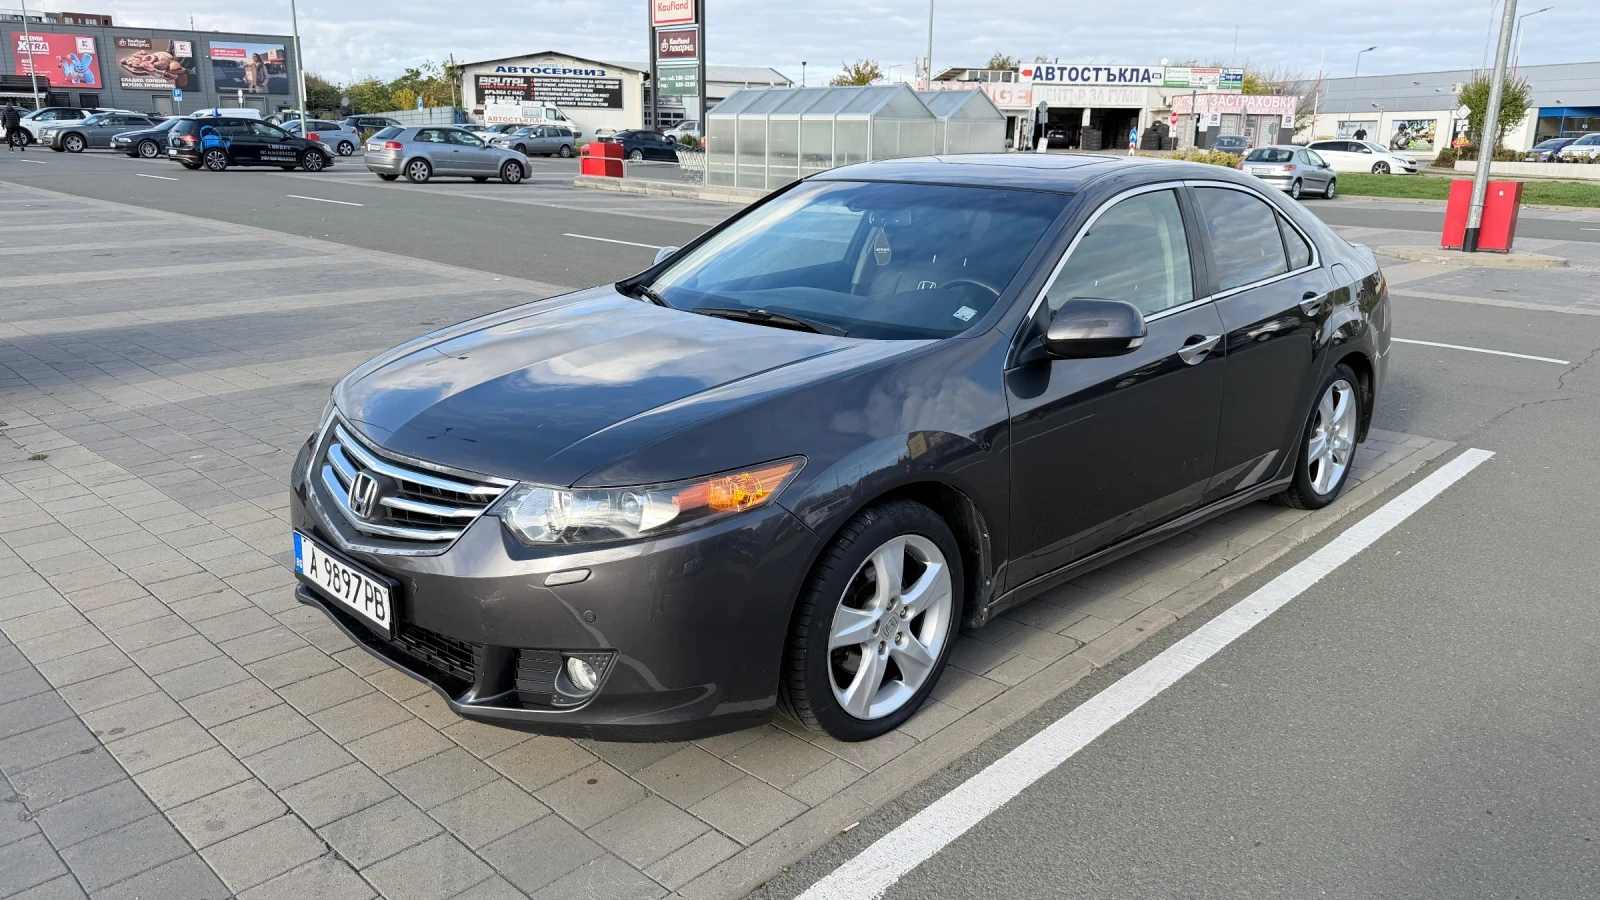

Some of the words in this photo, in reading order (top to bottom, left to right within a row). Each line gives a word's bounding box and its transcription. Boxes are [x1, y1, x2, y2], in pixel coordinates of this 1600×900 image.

[658, 2, 688, 12] Kaufland
[670, 37, 690, 45] Kaufland
[496, 66, 606, 76] АВТОСЕРВИЗ
[1032, 66, 1151, 82] АВТОСТЪКЛА
[479, 77, 527, 86] BRUTAL
[1108, 88, 1143, 102] ГУМИ
[1210, 95, 1295, 108] ЗАСТРАХОВКИ
[310, 548, 318, 578] A
[324, 558, 362, 604] 9897
